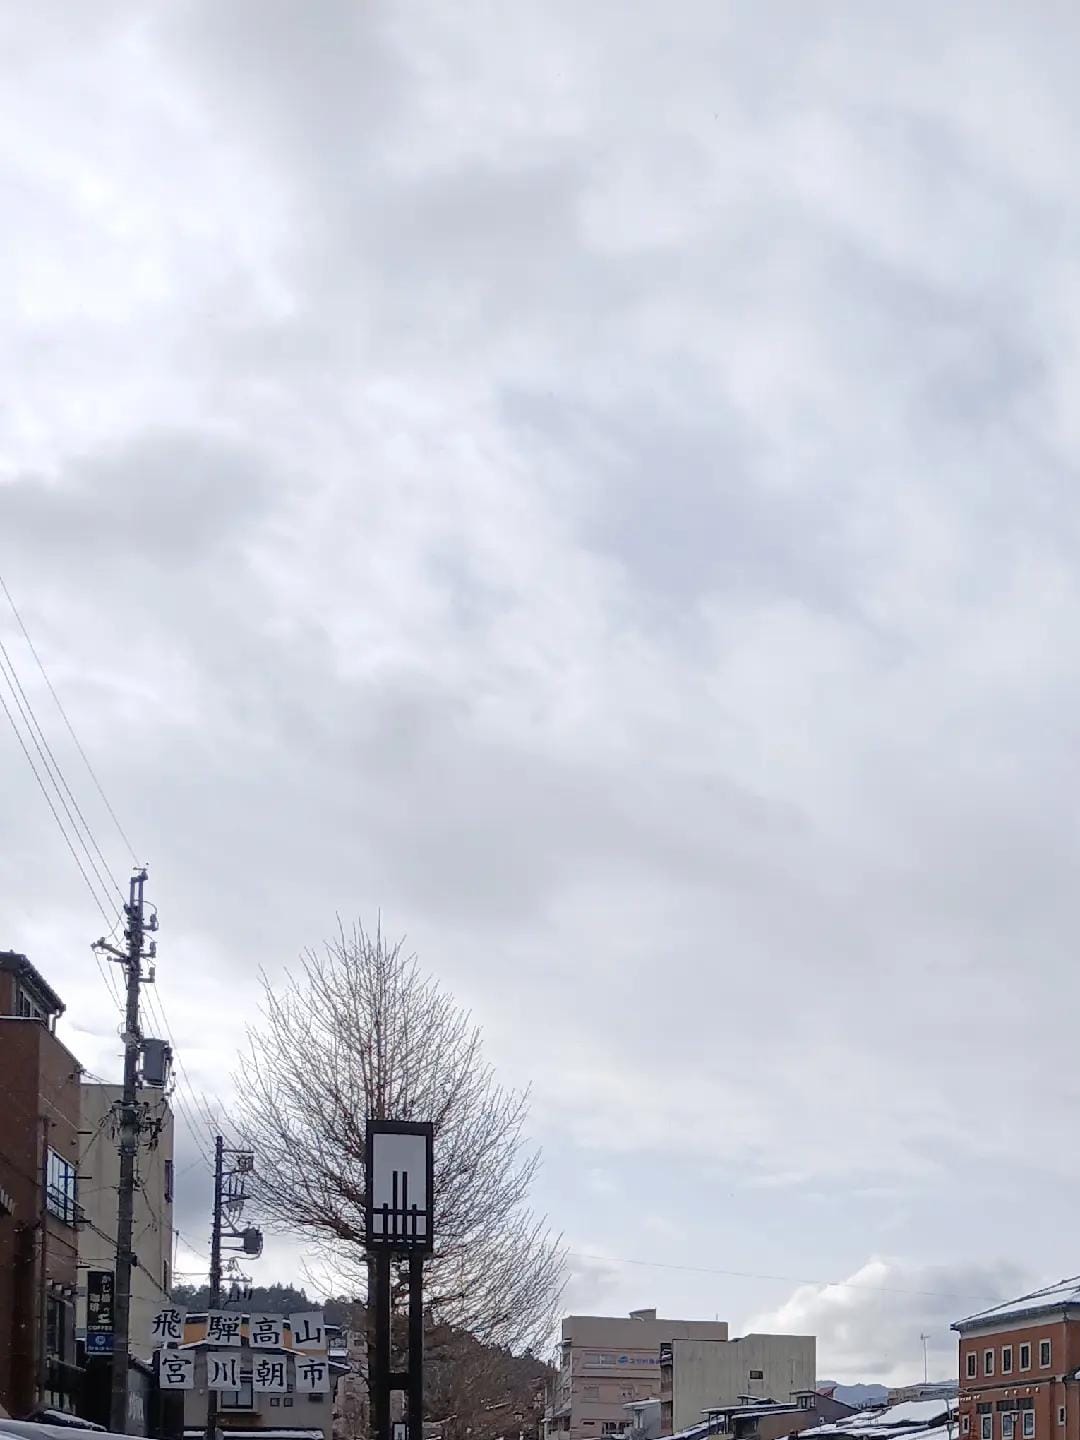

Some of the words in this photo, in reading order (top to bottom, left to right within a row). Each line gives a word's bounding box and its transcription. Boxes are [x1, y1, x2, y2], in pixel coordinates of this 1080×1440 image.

[152, 1308, 322, 1345] 飛騨高山
[162, 1354, 327, 1389] 宮川朝市
